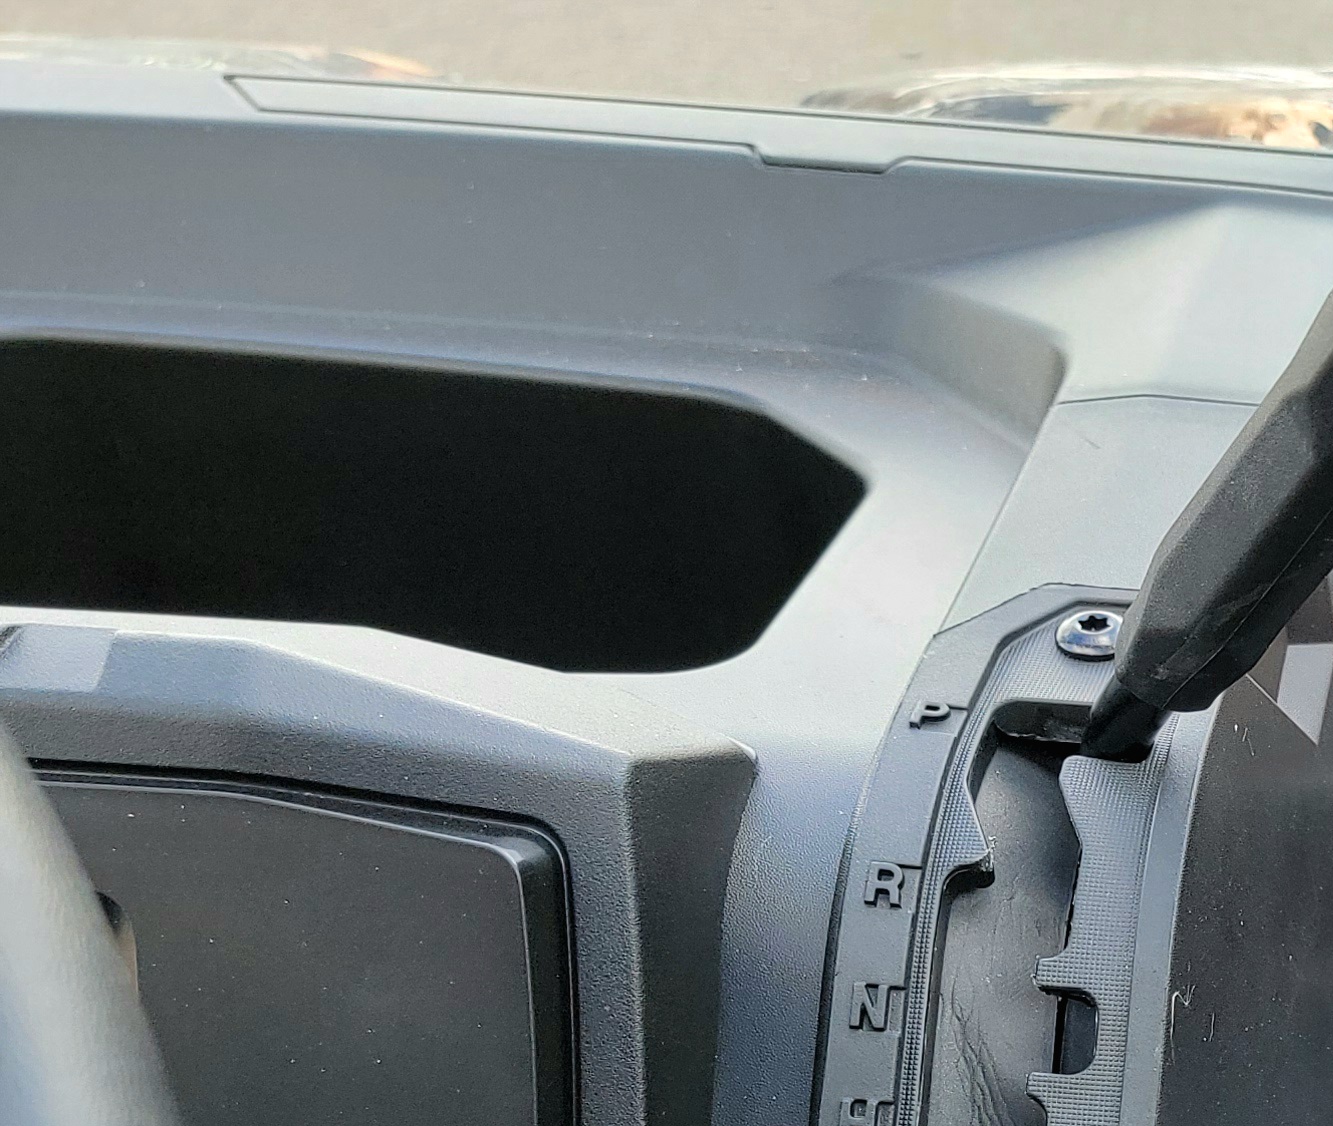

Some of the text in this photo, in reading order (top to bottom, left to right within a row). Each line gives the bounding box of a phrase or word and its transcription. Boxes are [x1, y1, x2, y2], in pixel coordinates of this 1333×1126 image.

[909, 700, 951, 729] P
[864, 861, 905, 908] R
[848, 983, 890, 1031] N
